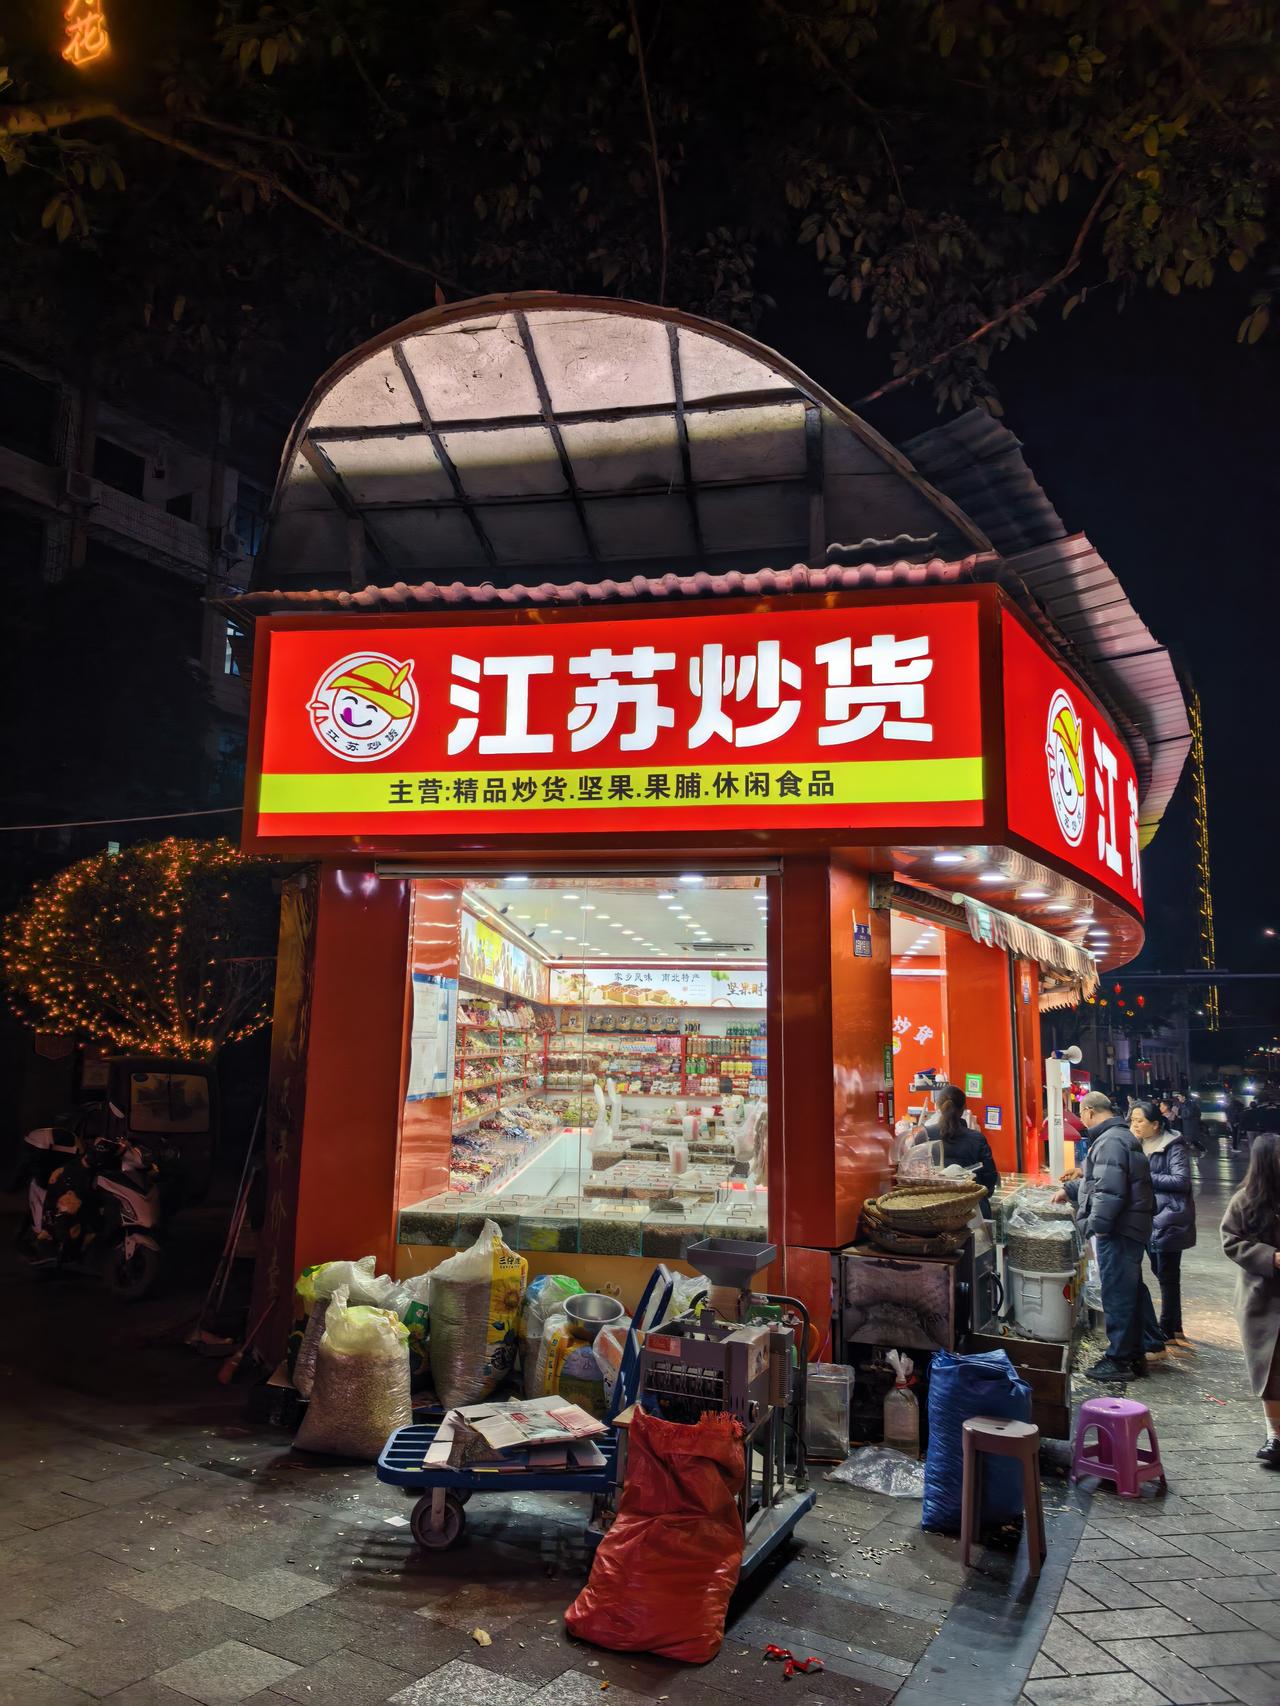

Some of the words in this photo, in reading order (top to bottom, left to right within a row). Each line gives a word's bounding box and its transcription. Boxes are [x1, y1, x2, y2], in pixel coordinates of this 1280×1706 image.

[447, 634, 934, 756] 江苏炒货
[614, 971, 653, 982] 家乡风味
[661, 972, 701, 983] 南北特产
[726, 982, 767, 997] 坚果时
